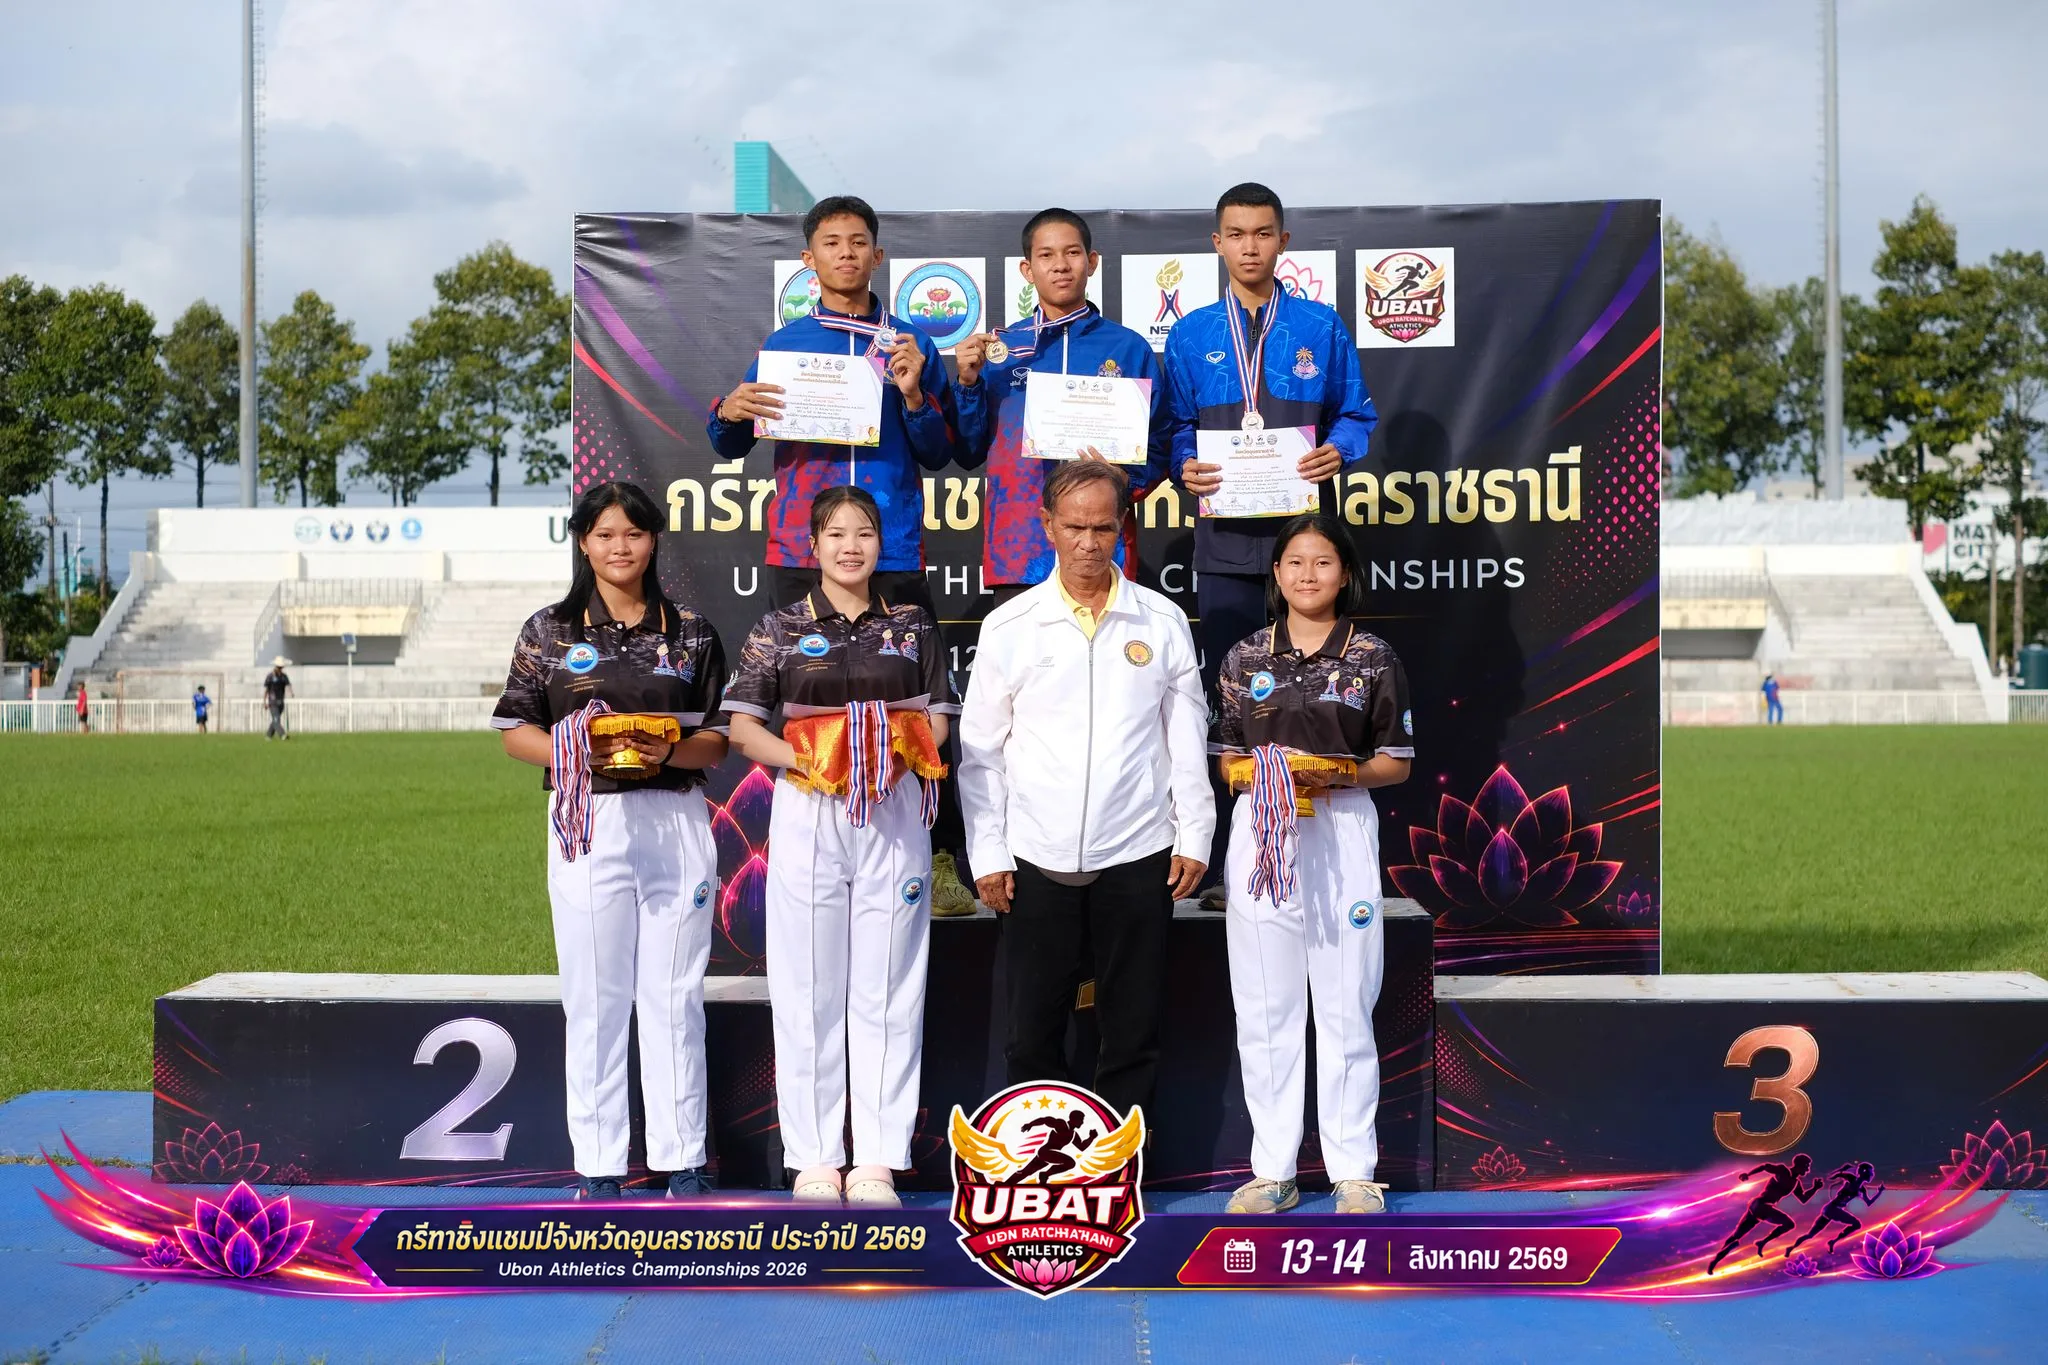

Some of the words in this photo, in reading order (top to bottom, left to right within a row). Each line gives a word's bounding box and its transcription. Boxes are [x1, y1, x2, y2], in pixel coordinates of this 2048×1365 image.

[1150, 325, 1173, 335] NS
[1372, 298, 1439, 317] UBAT
[400, 1017, 517, 1161] 2
[1712, 1025, 1820, 1156] 3
